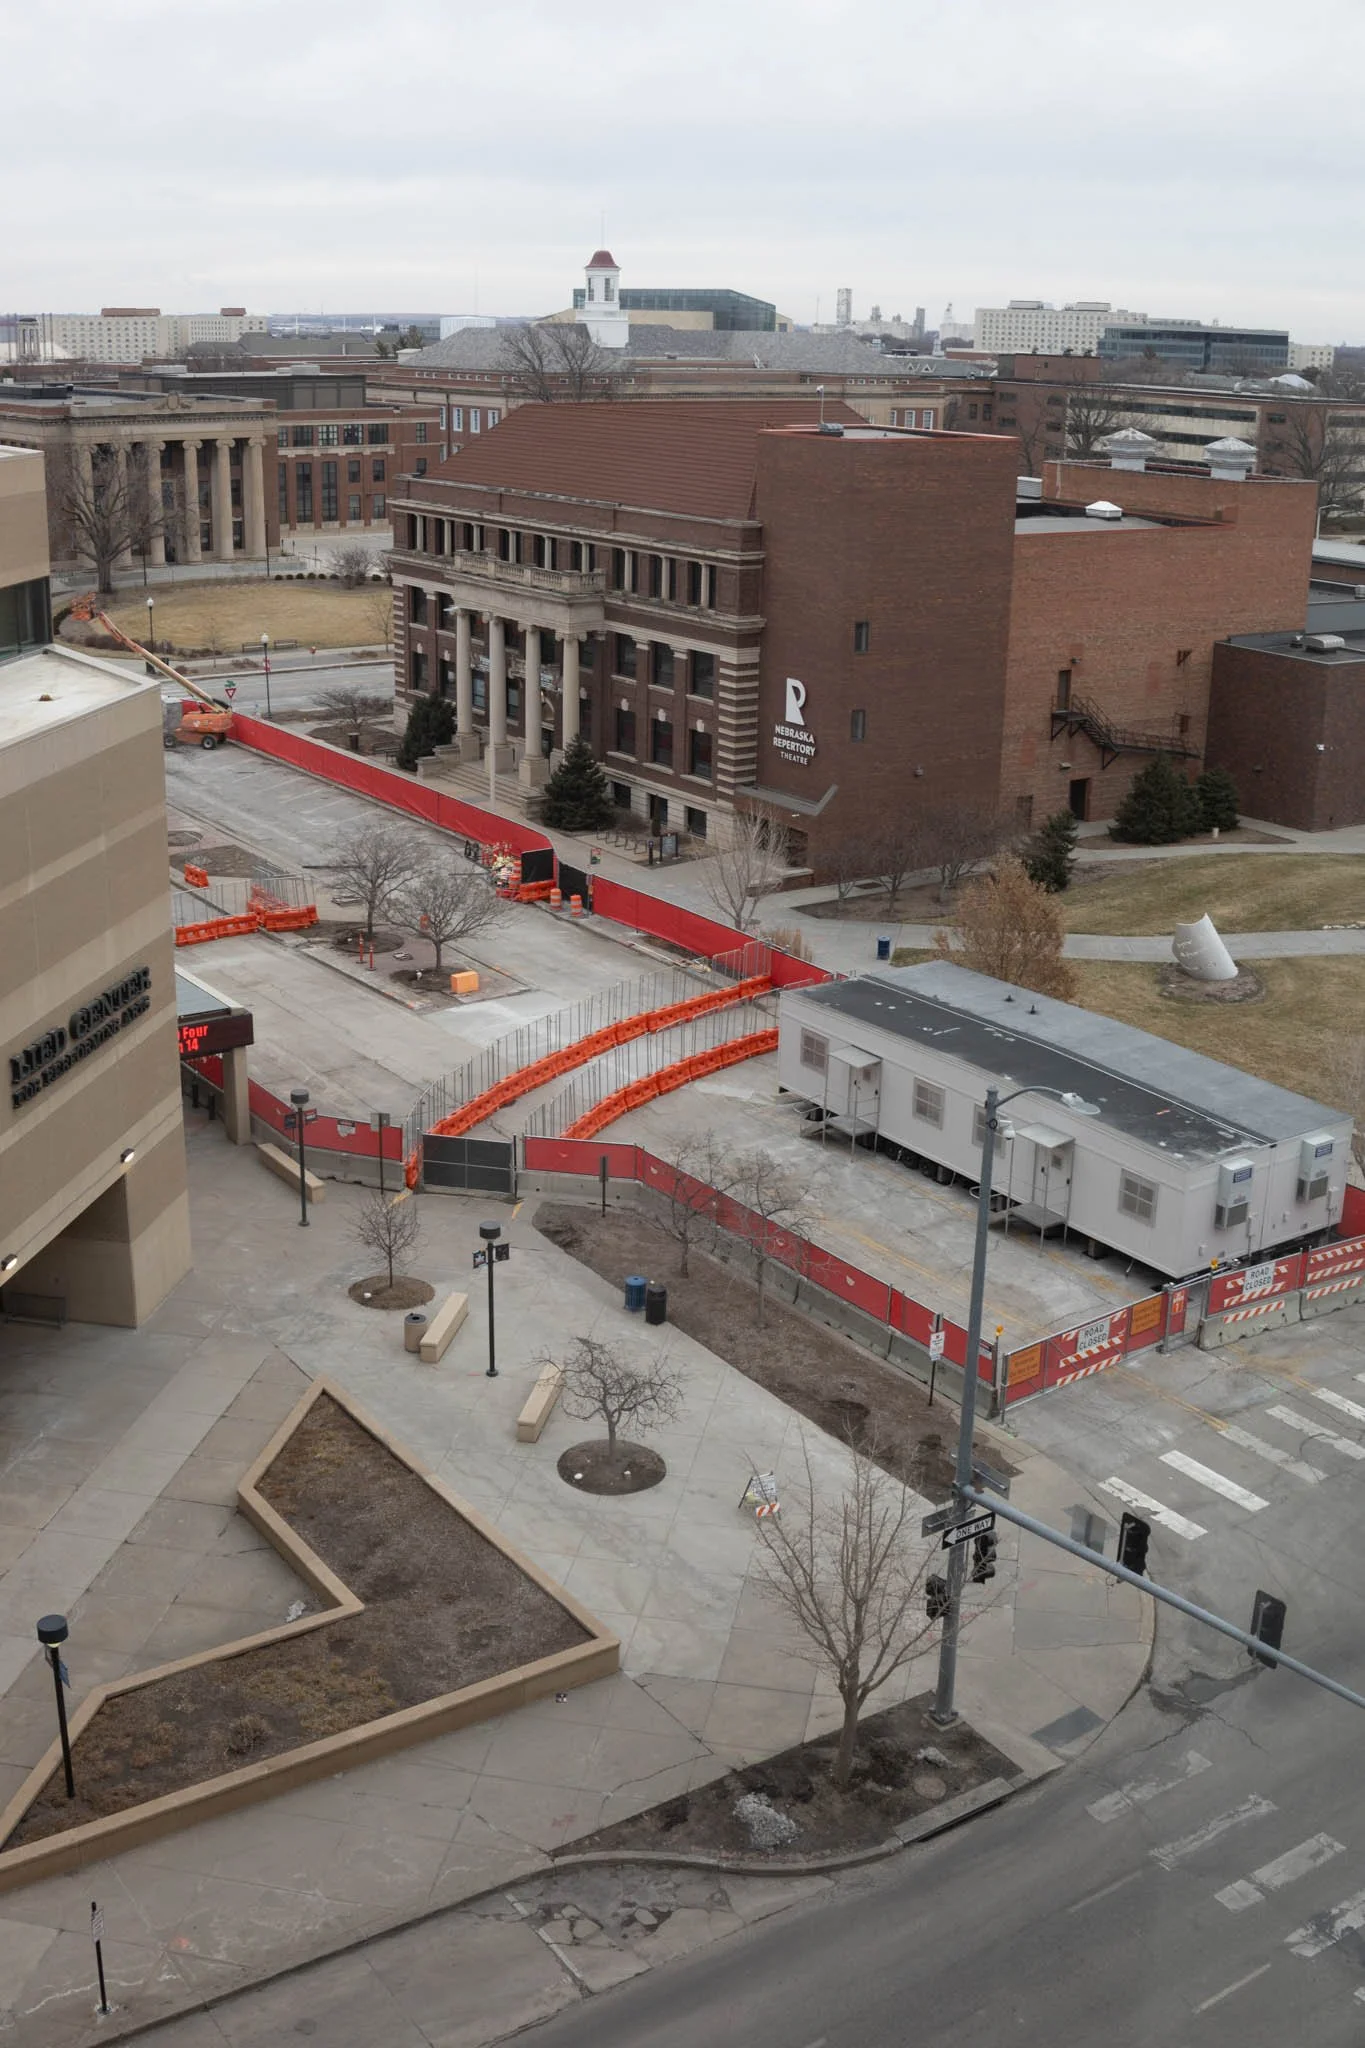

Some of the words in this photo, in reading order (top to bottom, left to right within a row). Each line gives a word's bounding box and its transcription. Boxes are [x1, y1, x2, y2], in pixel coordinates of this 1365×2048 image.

[775, 723, 815, 744] NEBRASKA
[773, 736, 816, 757] REPERTORY
[780, 751, 808, 766] THEATRE
[10, 1026, 67, 1084] LIED
[69, 966, 152, 1040] CENTER
[182, 1024, 209, 1039] Four
[185, 1037, 199, 1052] 14
[1250, 1266, 1270, 1279] ROAD
[1245, 1276, 1272, 1291] CLOSED
[1084, 1323, 1105, 1338] ROAD
[1078, 1332, 1107, 1350] CLOSED
[956, 1525, 973, 1538] ONE
[974, 1518, 990, 1531] WAY
